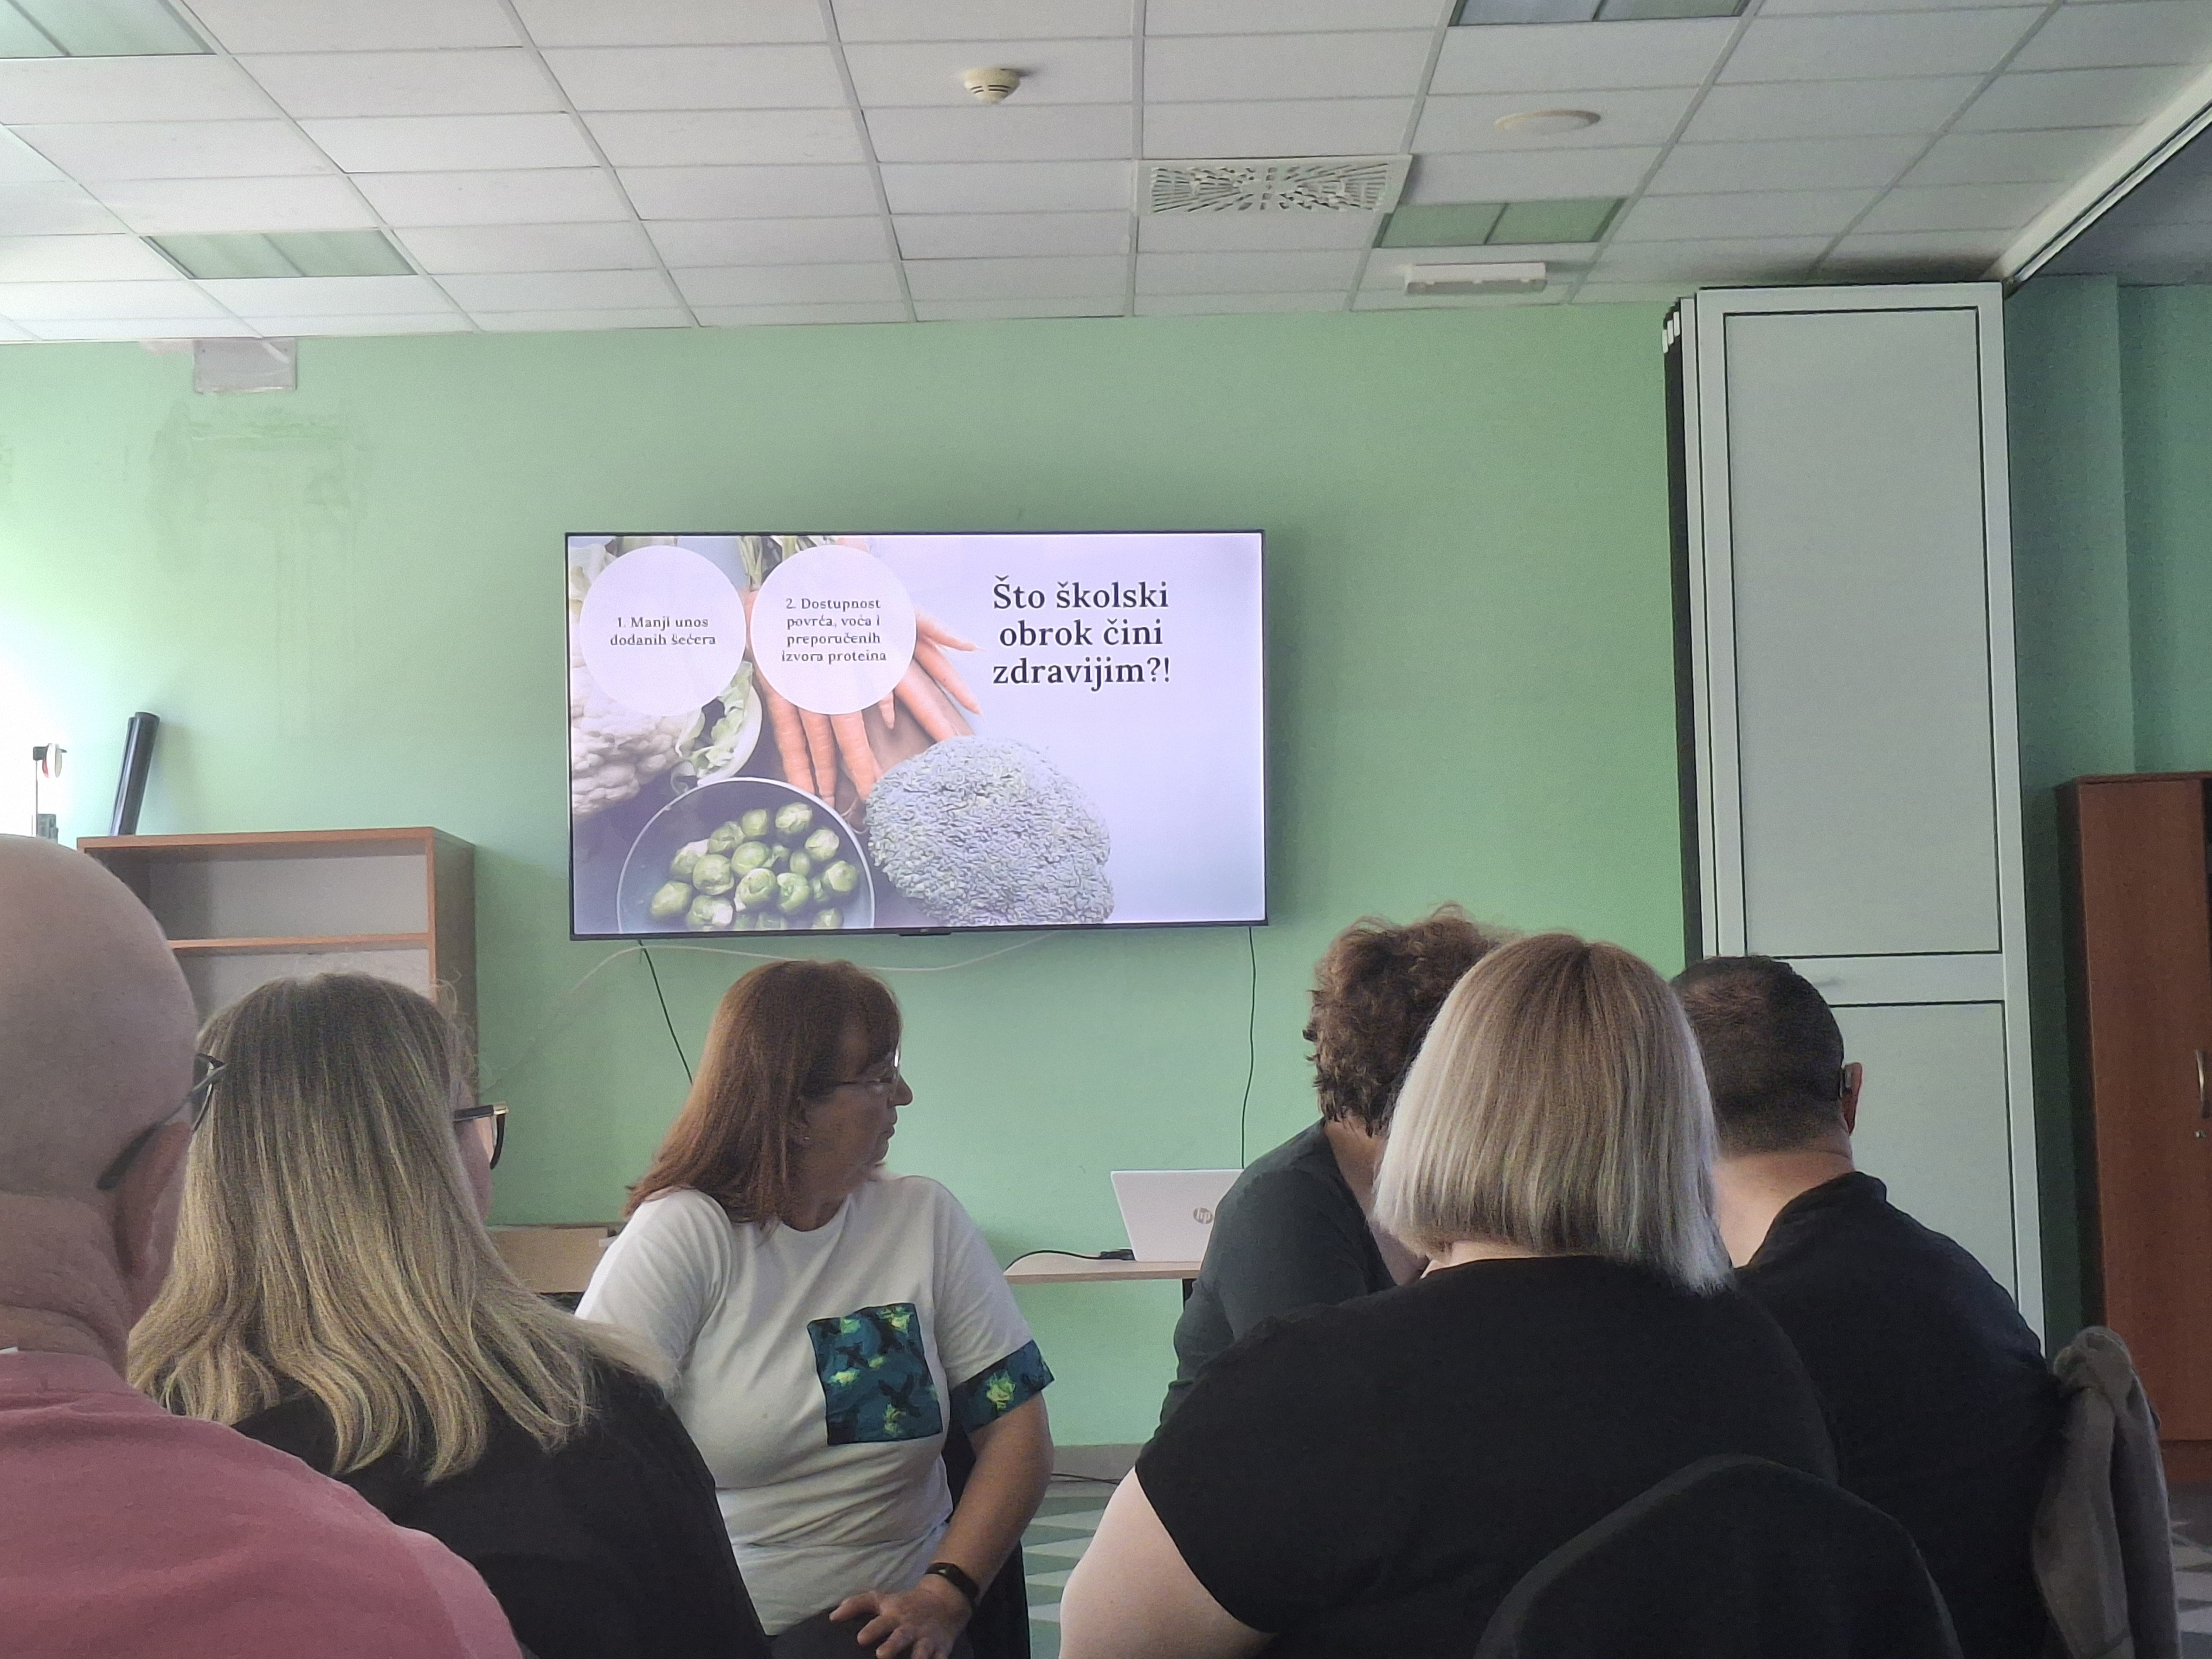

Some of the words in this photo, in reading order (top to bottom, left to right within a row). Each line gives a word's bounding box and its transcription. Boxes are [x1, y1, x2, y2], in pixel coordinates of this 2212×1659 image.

[993, 575, 1045, 609] Što
[1056, 581, 1169, 609] školski
[801, 597, 881, 612] Dostupnost
[631, 616, 670, 631] Manji
[675, 619, 709, 628] unos
[787, 614, 837, 630] povrća,
[610, 633, 667, 646] dodanih
[786, 632, 880, 648] preporučenih
[999, 619, 1092, 647] obrok
[1103, 618, 1163, 646] čini
[782, 650, 824, 662] izvora
[828, 650, 887, 665] proteina
[992, 656, 1170, 692] zdravijim?!
